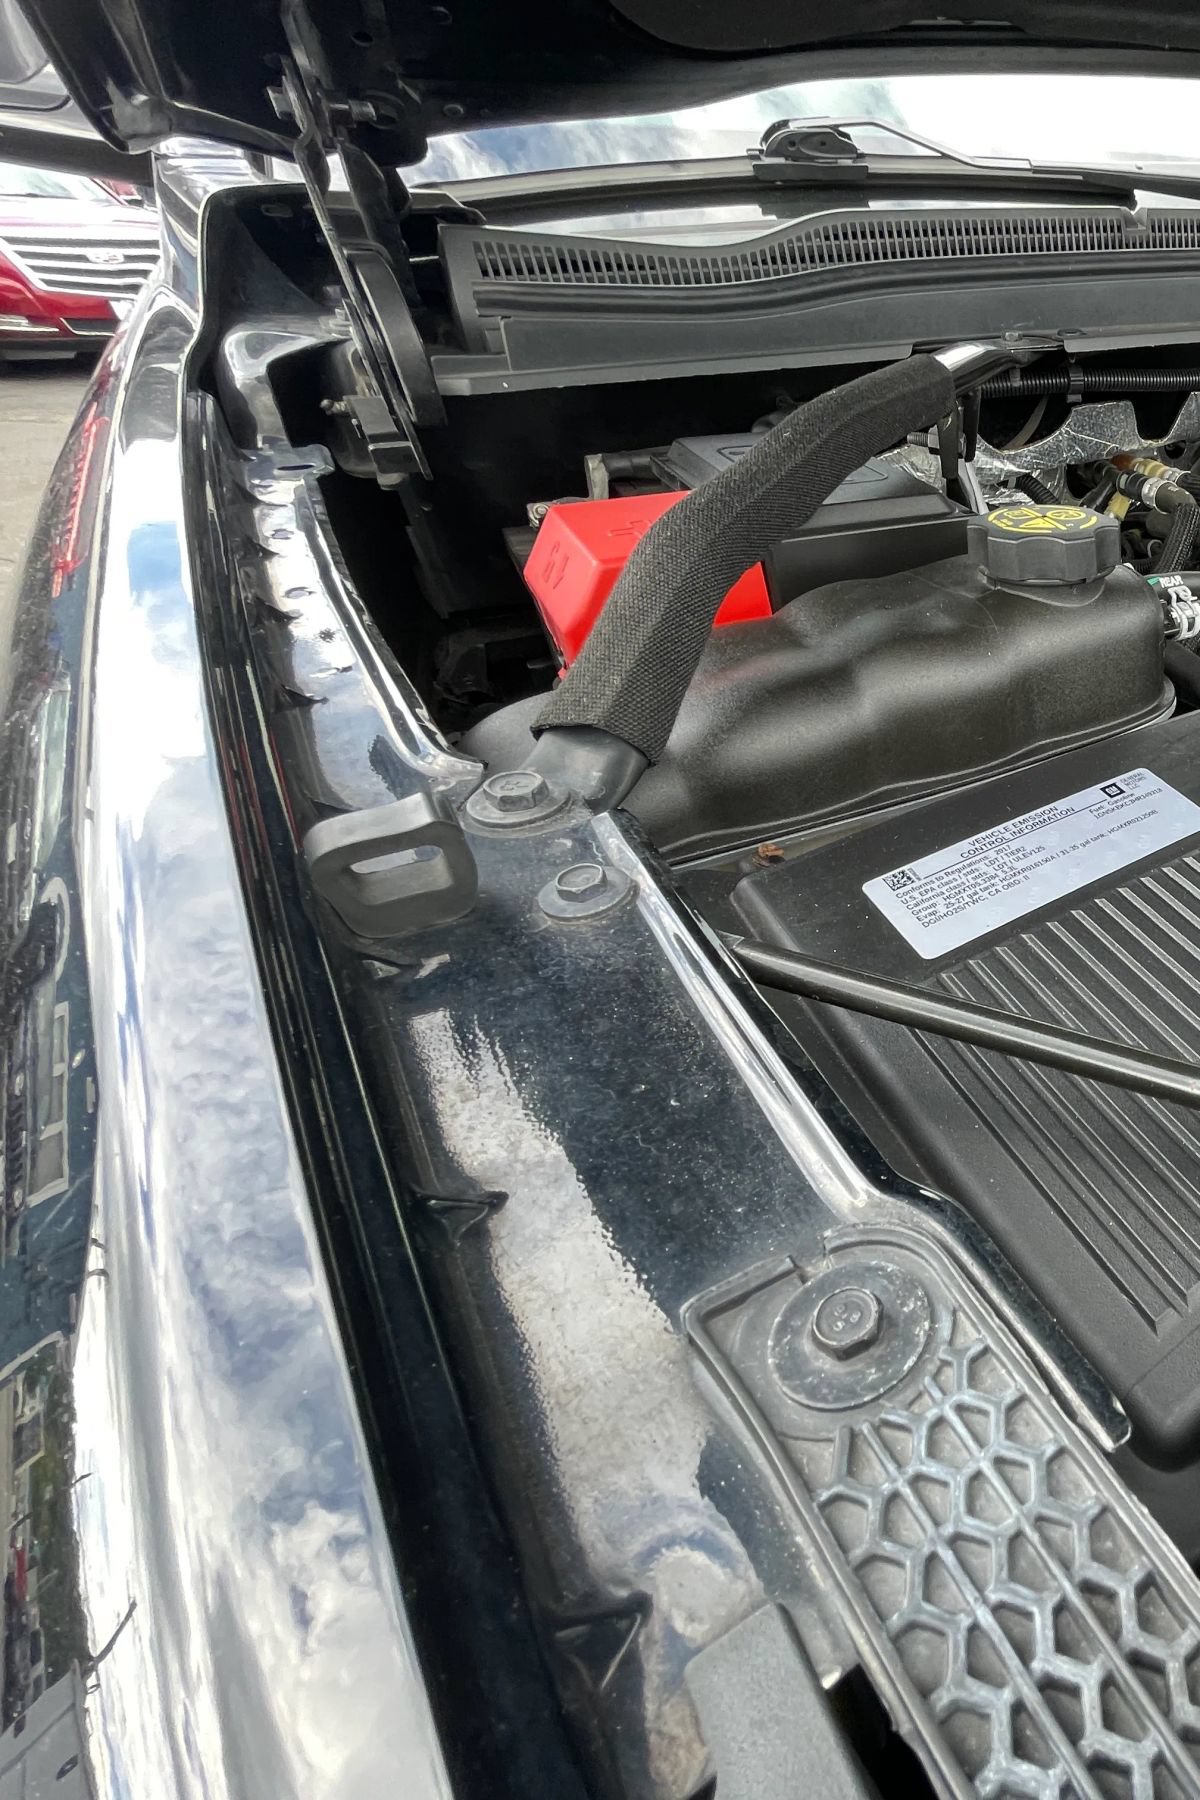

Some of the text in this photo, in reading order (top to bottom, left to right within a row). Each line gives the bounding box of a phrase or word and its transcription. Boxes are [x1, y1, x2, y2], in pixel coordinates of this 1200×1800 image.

[1159, 575, 1184, 589] REAR
[960, 807, 1075, 858] CONTROL INFORMATION
[968, 806, 1058, 846] VEHICLE EMISSION
[896, 880, 935, 899] Conforms
[944, 856, 991, 877] Regulations:
[994, 844, 1011, 855] 2017
[900, 895, 918, 904] U.S.
[918, 887, 936, 896] EPA
[937, 877, 958, 889] class
[984, 857, 1000, 867] LDT
[906, 891, 945, 910] California
[945, 881, 966, 893] class
[992, 861, 1008, 871] LDT
[1012, 846, 1046, 862] ULEV125
[966, 890, 979, 900] gal
[1079, 839, 1091, 847] gal
[988, 888, 1002, 896] CA
[911, 901, 940, 916] Group:
